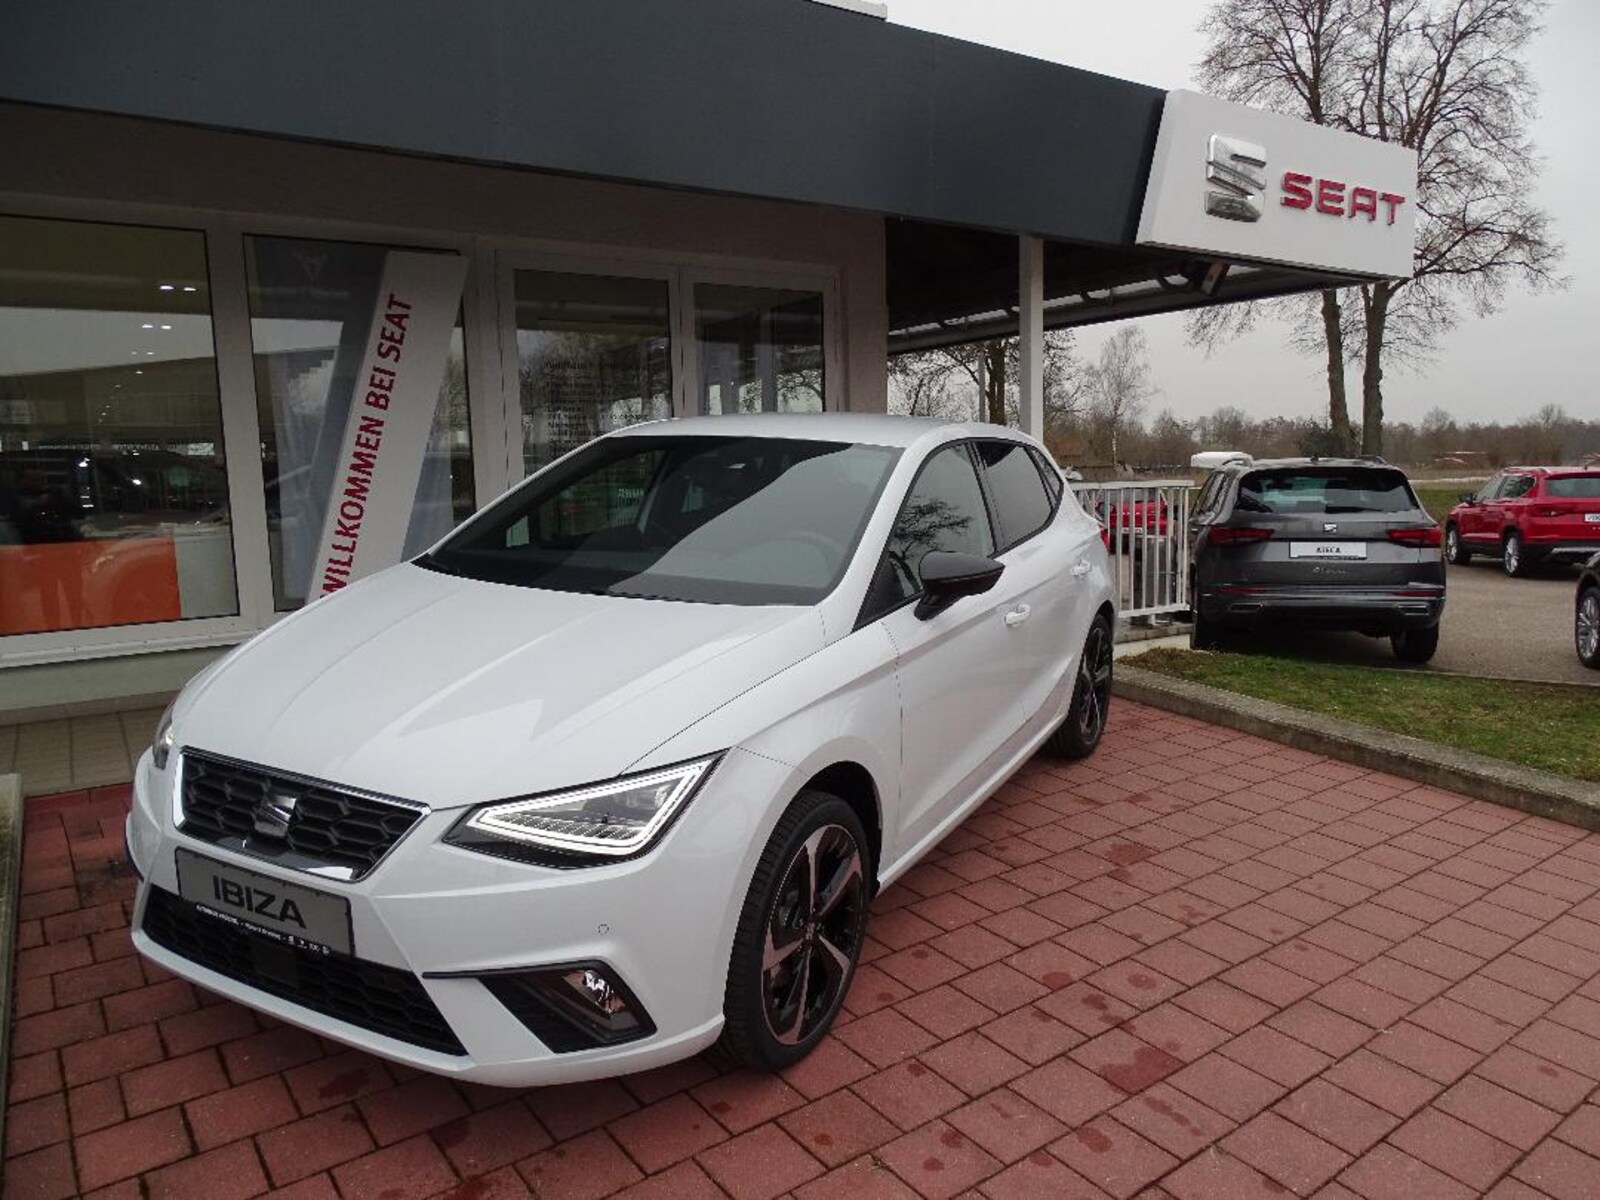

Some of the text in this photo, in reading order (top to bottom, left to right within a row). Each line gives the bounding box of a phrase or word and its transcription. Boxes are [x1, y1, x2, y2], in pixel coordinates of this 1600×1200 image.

[1280, 171, 1405, 226] SEAT
[319, 293, 412, 599] WILLKOMMEN BEI SEAT
[212, 875, 307, 929] IBIZA
